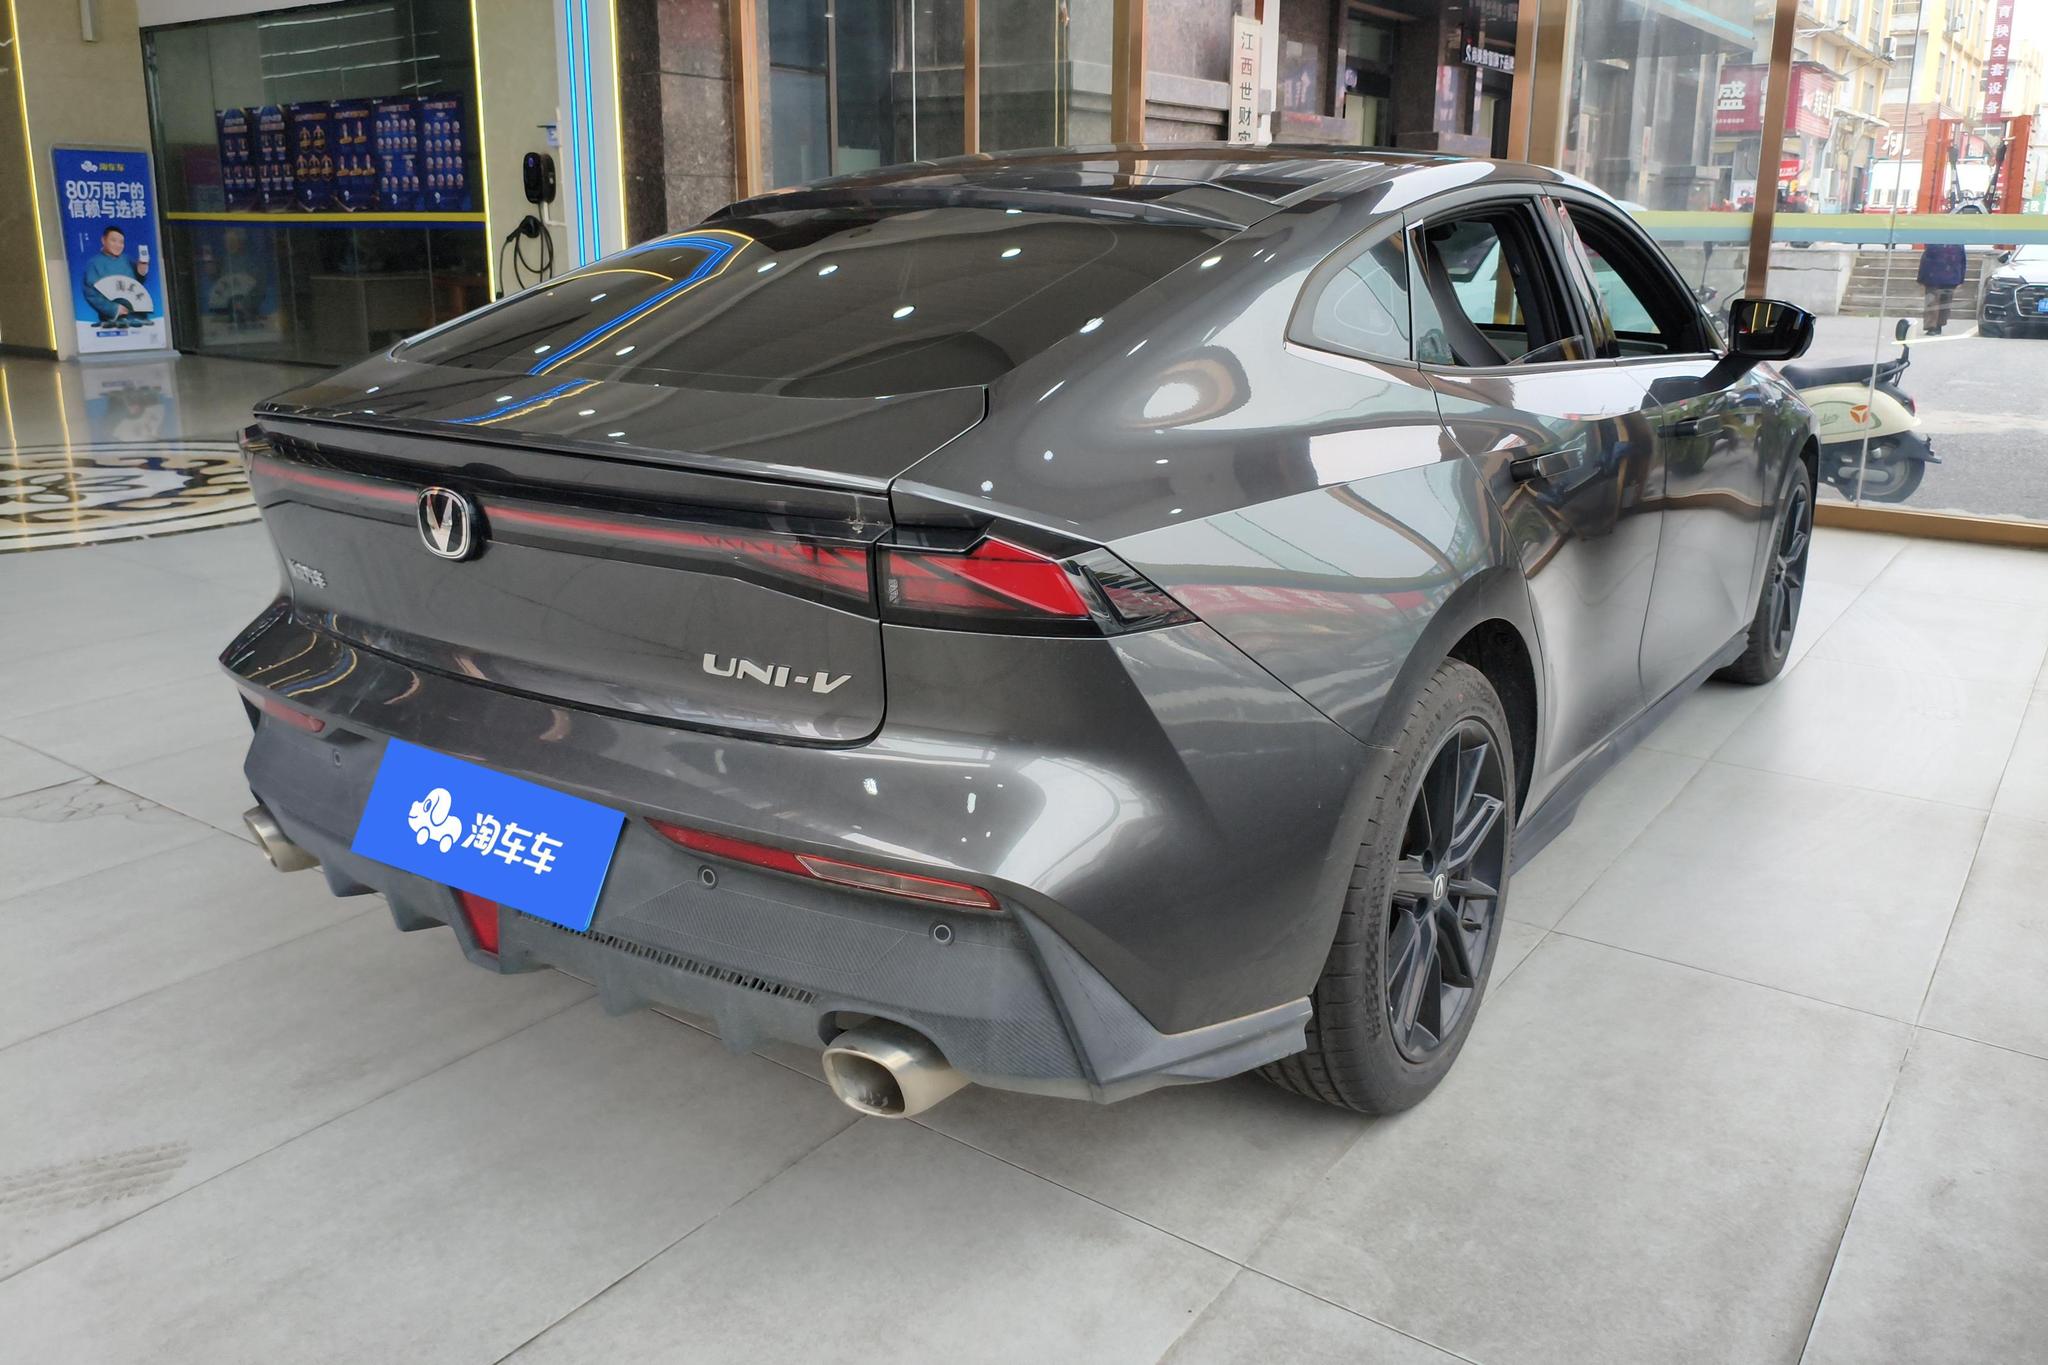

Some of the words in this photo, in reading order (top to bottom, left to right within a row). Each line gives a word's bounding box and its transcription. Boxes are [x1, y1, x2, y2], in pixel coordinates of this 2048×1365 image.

[65, 180, 145, 199] 80万用户的
[68, 199, 147, 218] 信赖与选择
[703, 653, 852, 694] UNI-V
